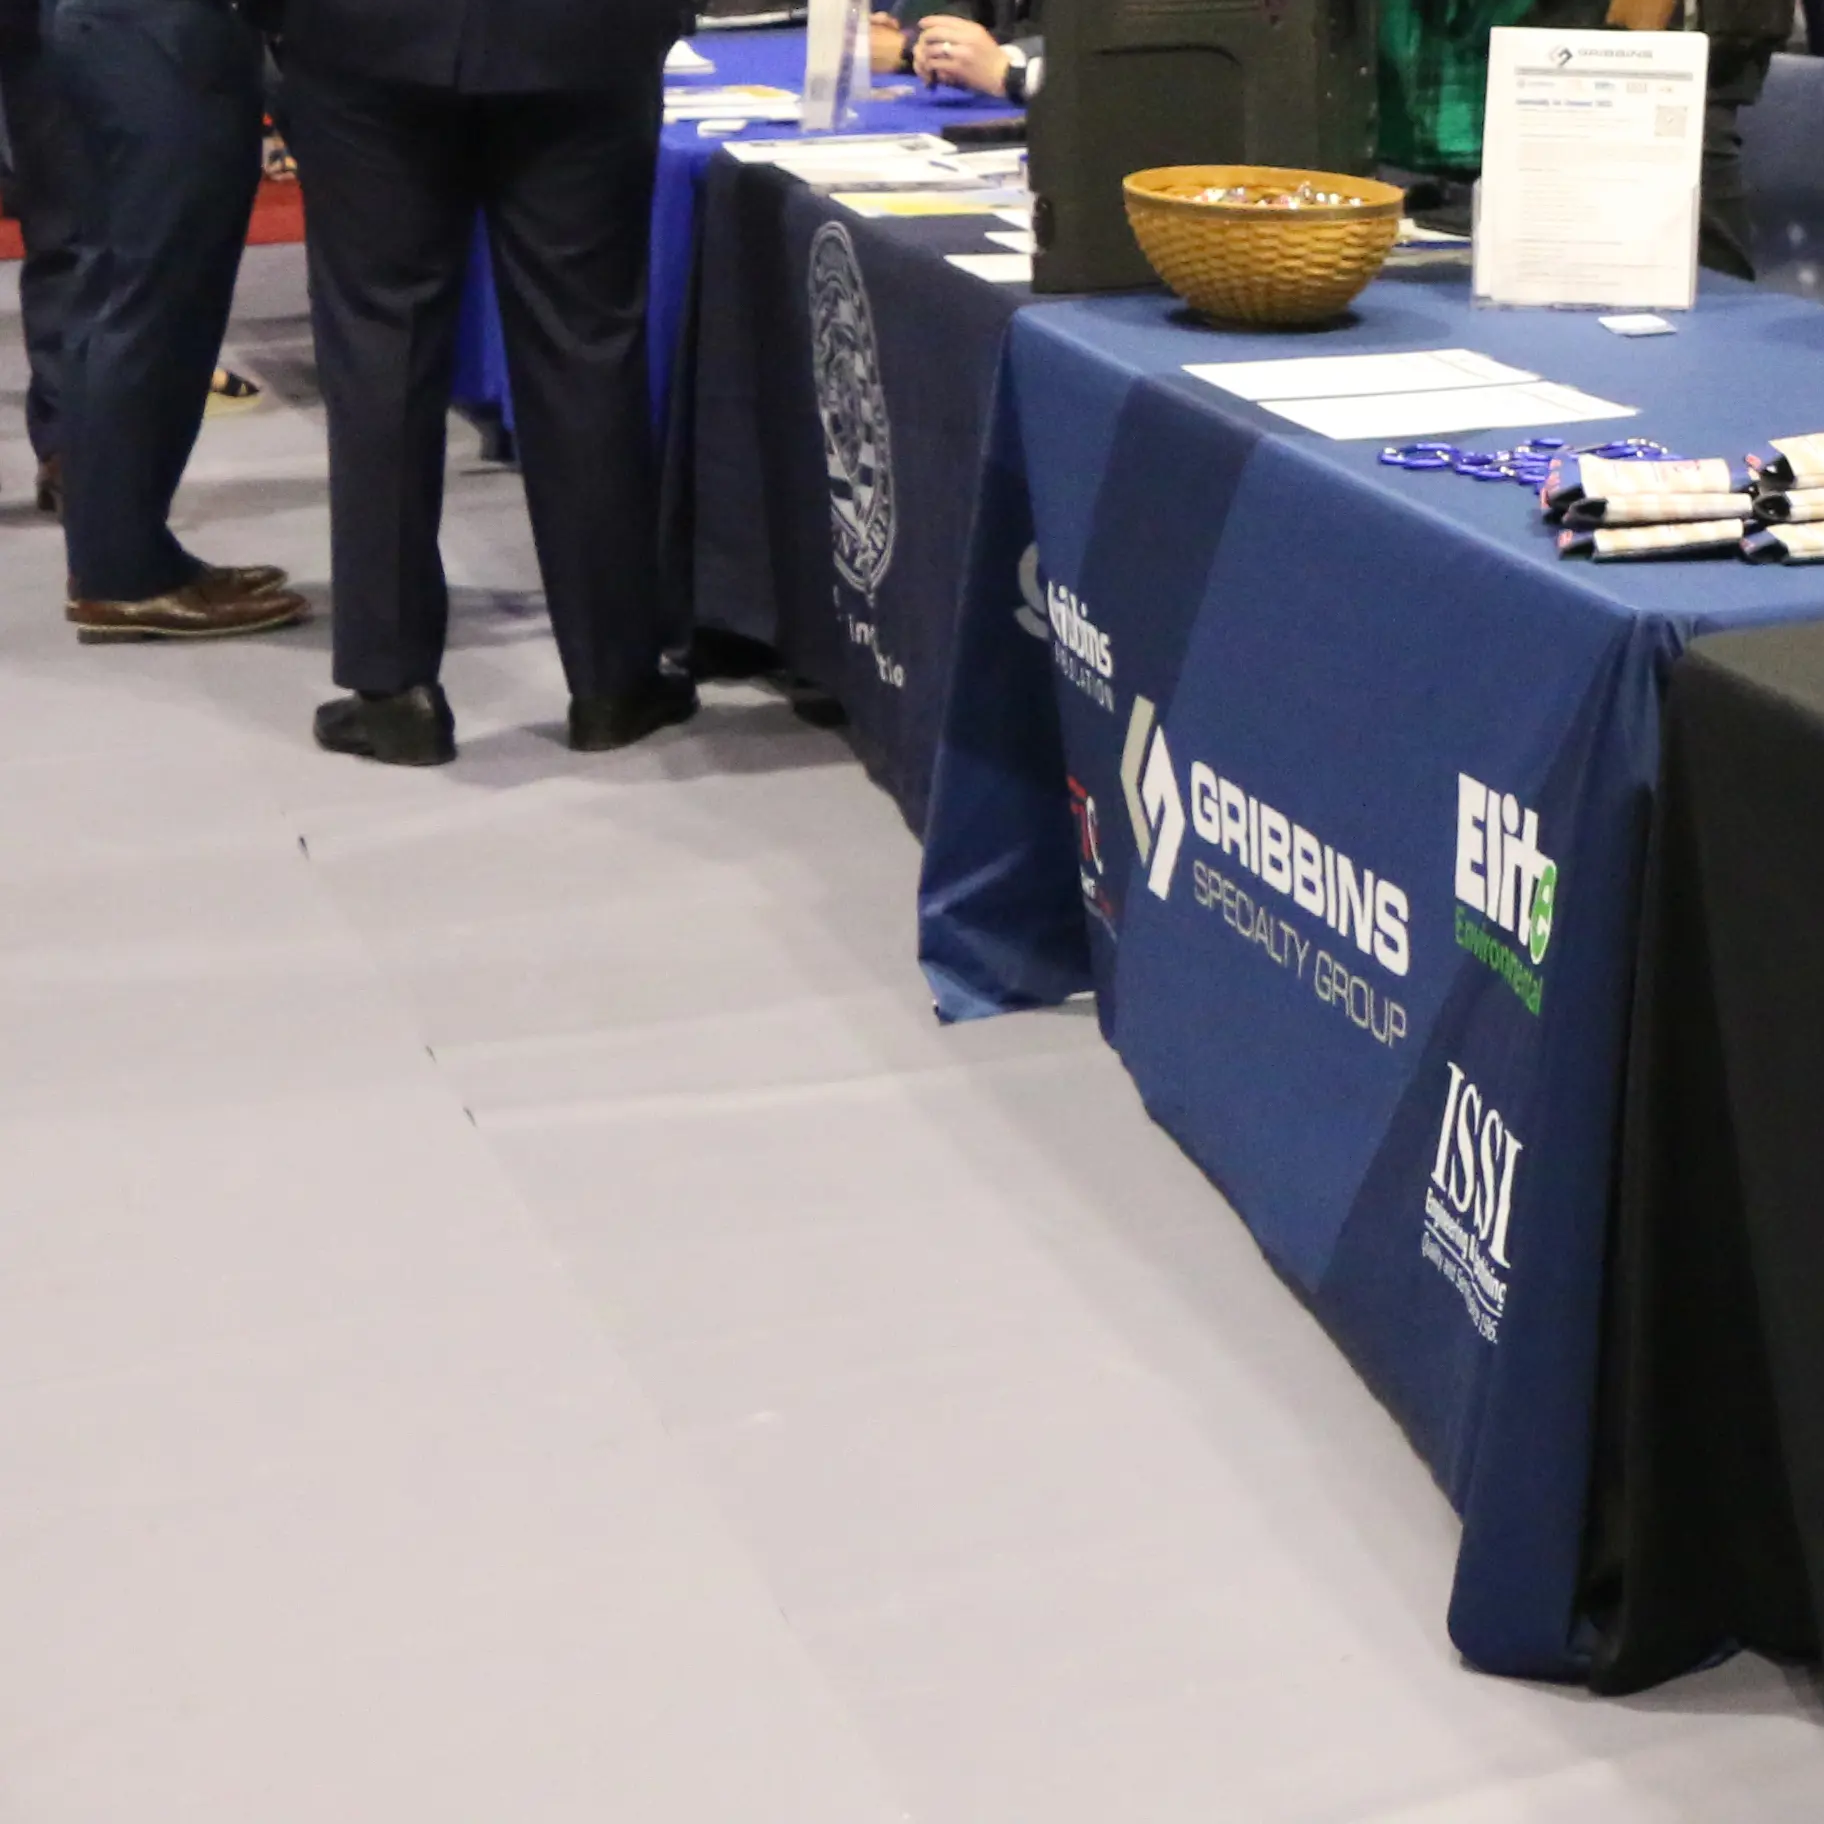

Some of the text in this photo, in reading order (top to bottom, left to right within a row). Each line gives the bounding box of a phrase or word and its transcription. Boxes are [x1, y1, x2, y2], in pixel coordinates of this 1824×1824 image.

[1192, 760, 1409, 976] GRIBBINS
[1194, 865, 1310, 977] SPECIALTY
[1314, 948, 1407, 1048] GROUP
[1455, 772, 1557, 965] Elite
[1431, 1061, 1523, 1269] ISSI
